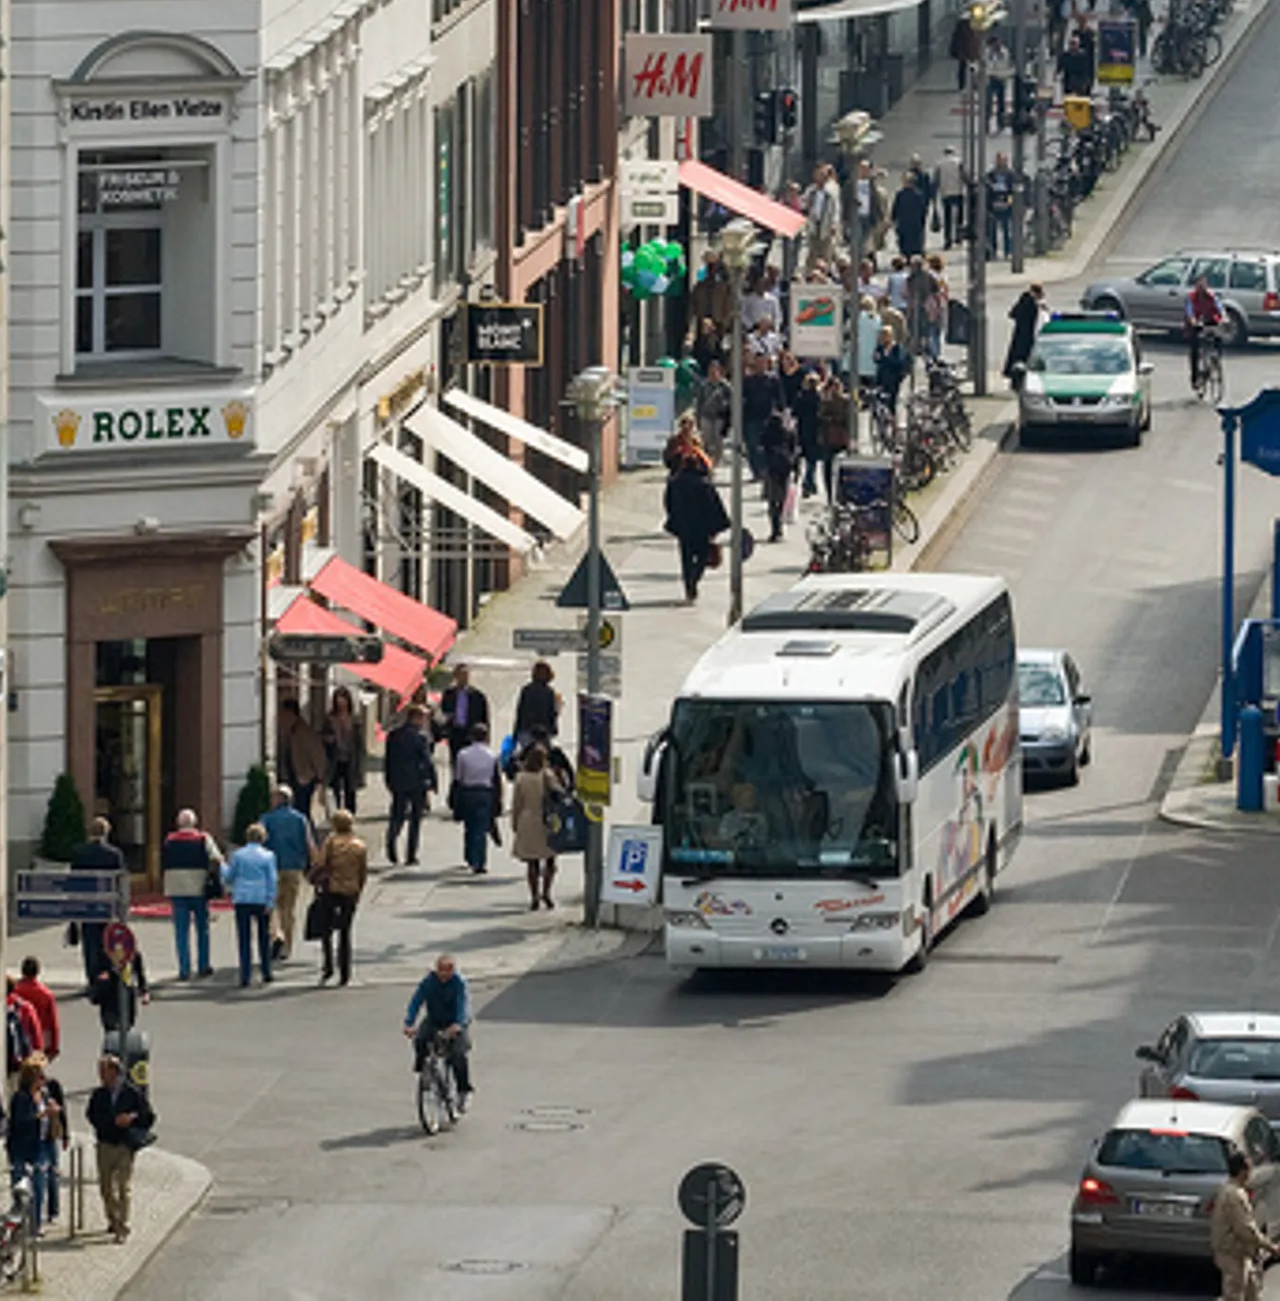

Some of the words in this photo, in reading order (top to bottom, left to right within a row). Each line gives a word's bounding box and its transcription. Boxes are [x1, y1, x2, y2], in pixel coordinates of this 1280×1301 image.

[633, 51, 704, 99] H&M
[130, 100, 169, 119] Ellen
[92, 406, 211, 442] ROLEX
